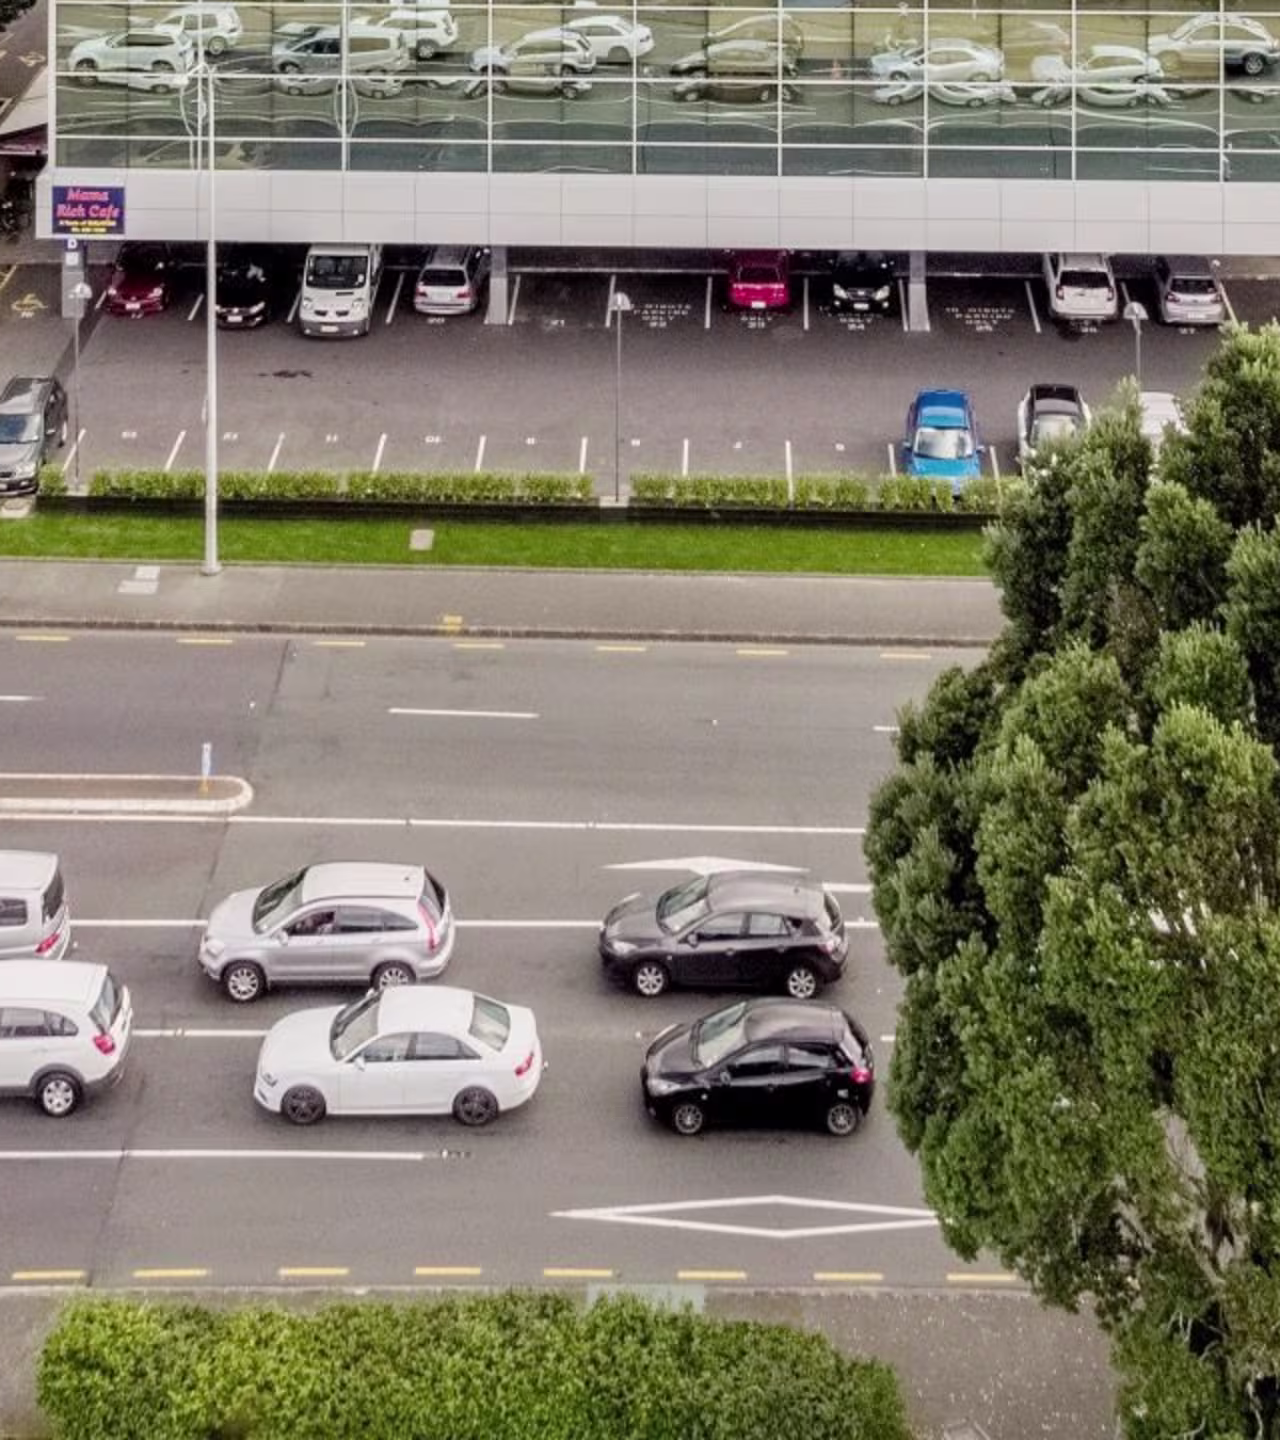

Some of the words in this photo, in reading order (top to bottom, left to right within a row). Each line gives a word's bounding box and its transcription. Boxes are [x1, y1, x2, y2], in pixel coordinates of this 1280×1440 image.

[66, 187, 109, 202] Mama
[56, 203, 86, 218] Rich
[88, 204, 120, 222] Cafe
